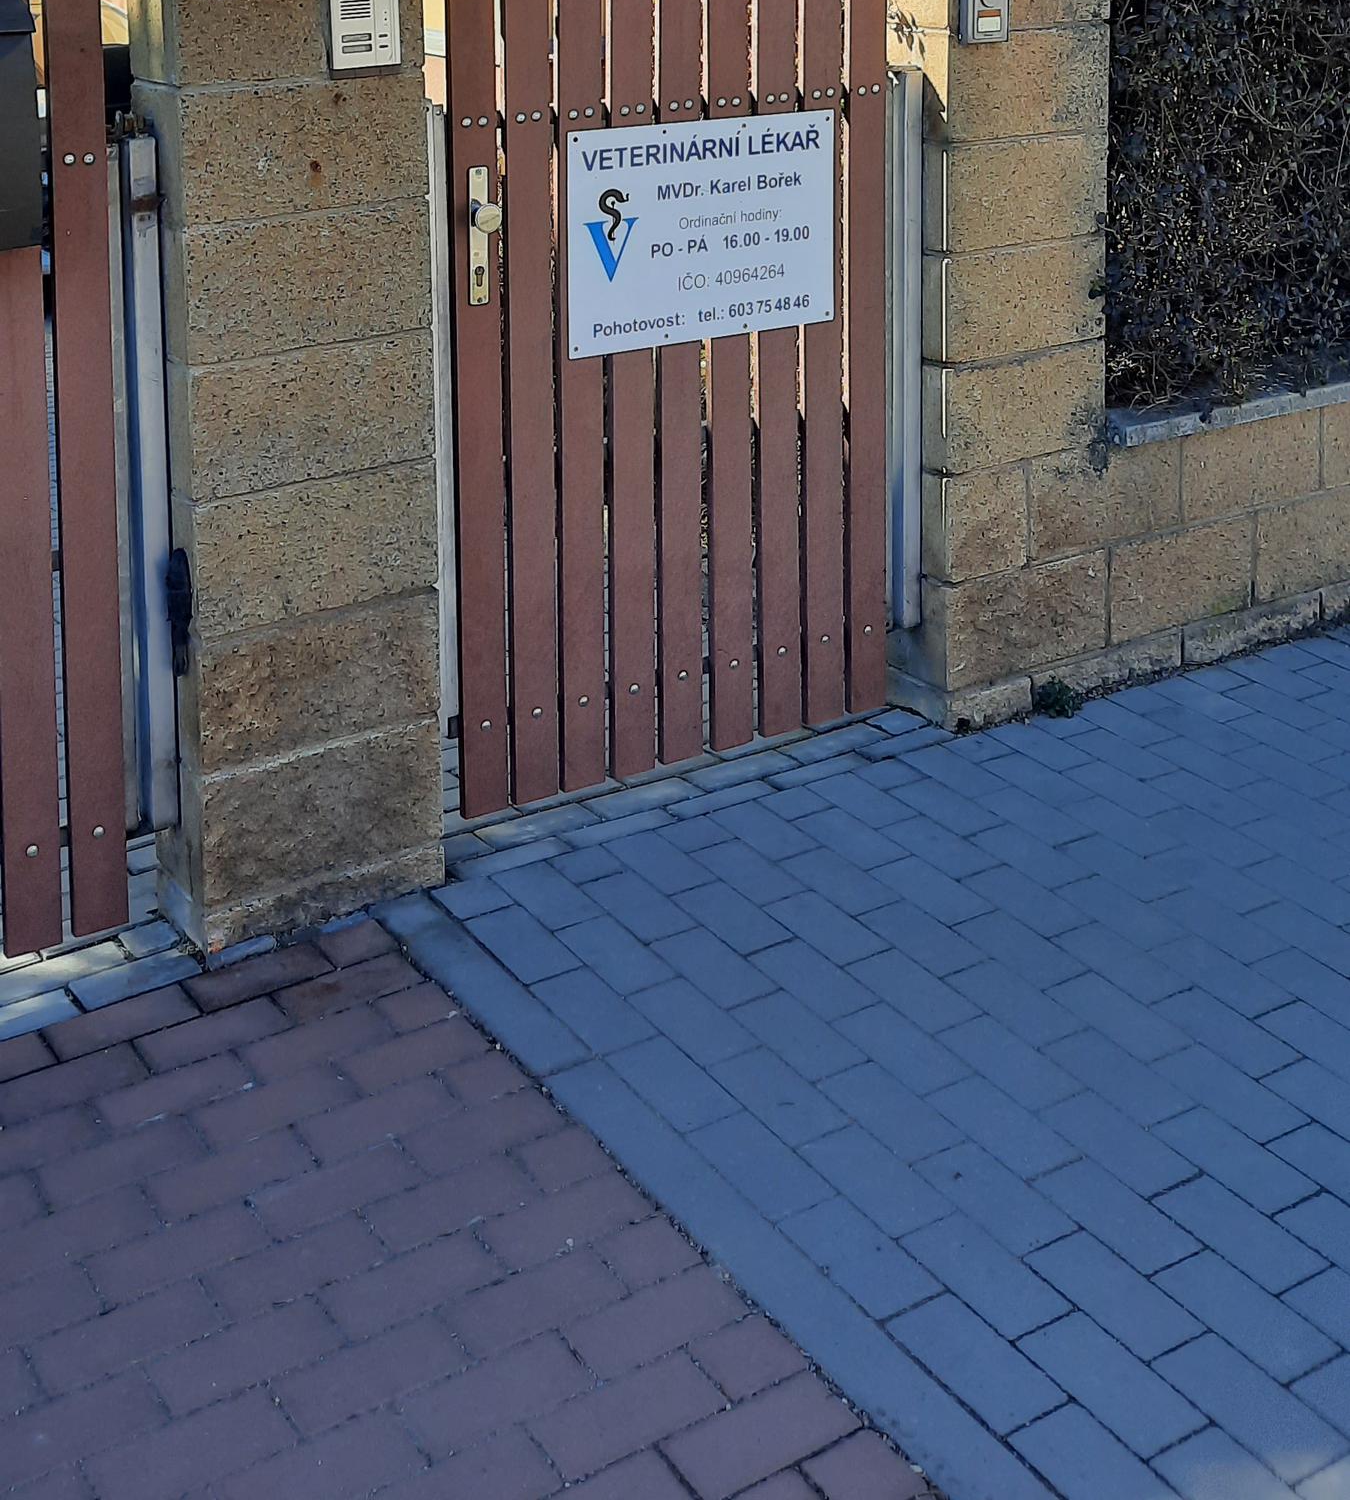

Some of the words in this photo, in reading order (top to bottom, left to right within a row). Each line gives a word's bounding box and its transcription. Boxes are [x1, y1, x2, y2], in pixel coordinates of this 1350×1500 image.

[582, 130, 741, 172] VETERINÁRNÍ
[748, 124, 820, 156] LÉKAŘ
[656, 181, 705, 201] MVDr.
[709, 176, 752, 196] Karel
[756, 171, 802, 190] Bořek
[679, 210, 737, 230] Ordinační
[739, 207, 783, 224] hodiny:
[651, 242, 674, 258] PO
[687, 234, 709, 254] PÁ
[722, 231, 761, 250] 16.00
[774, 225, 811, 244] 19.00
[677, 272, 711, 292] IČO:
[715, 263, 786, 286] 40964264
[593, 312, 686, 338] Pohotovost:
[698, 308, 725, 323] tel.:
